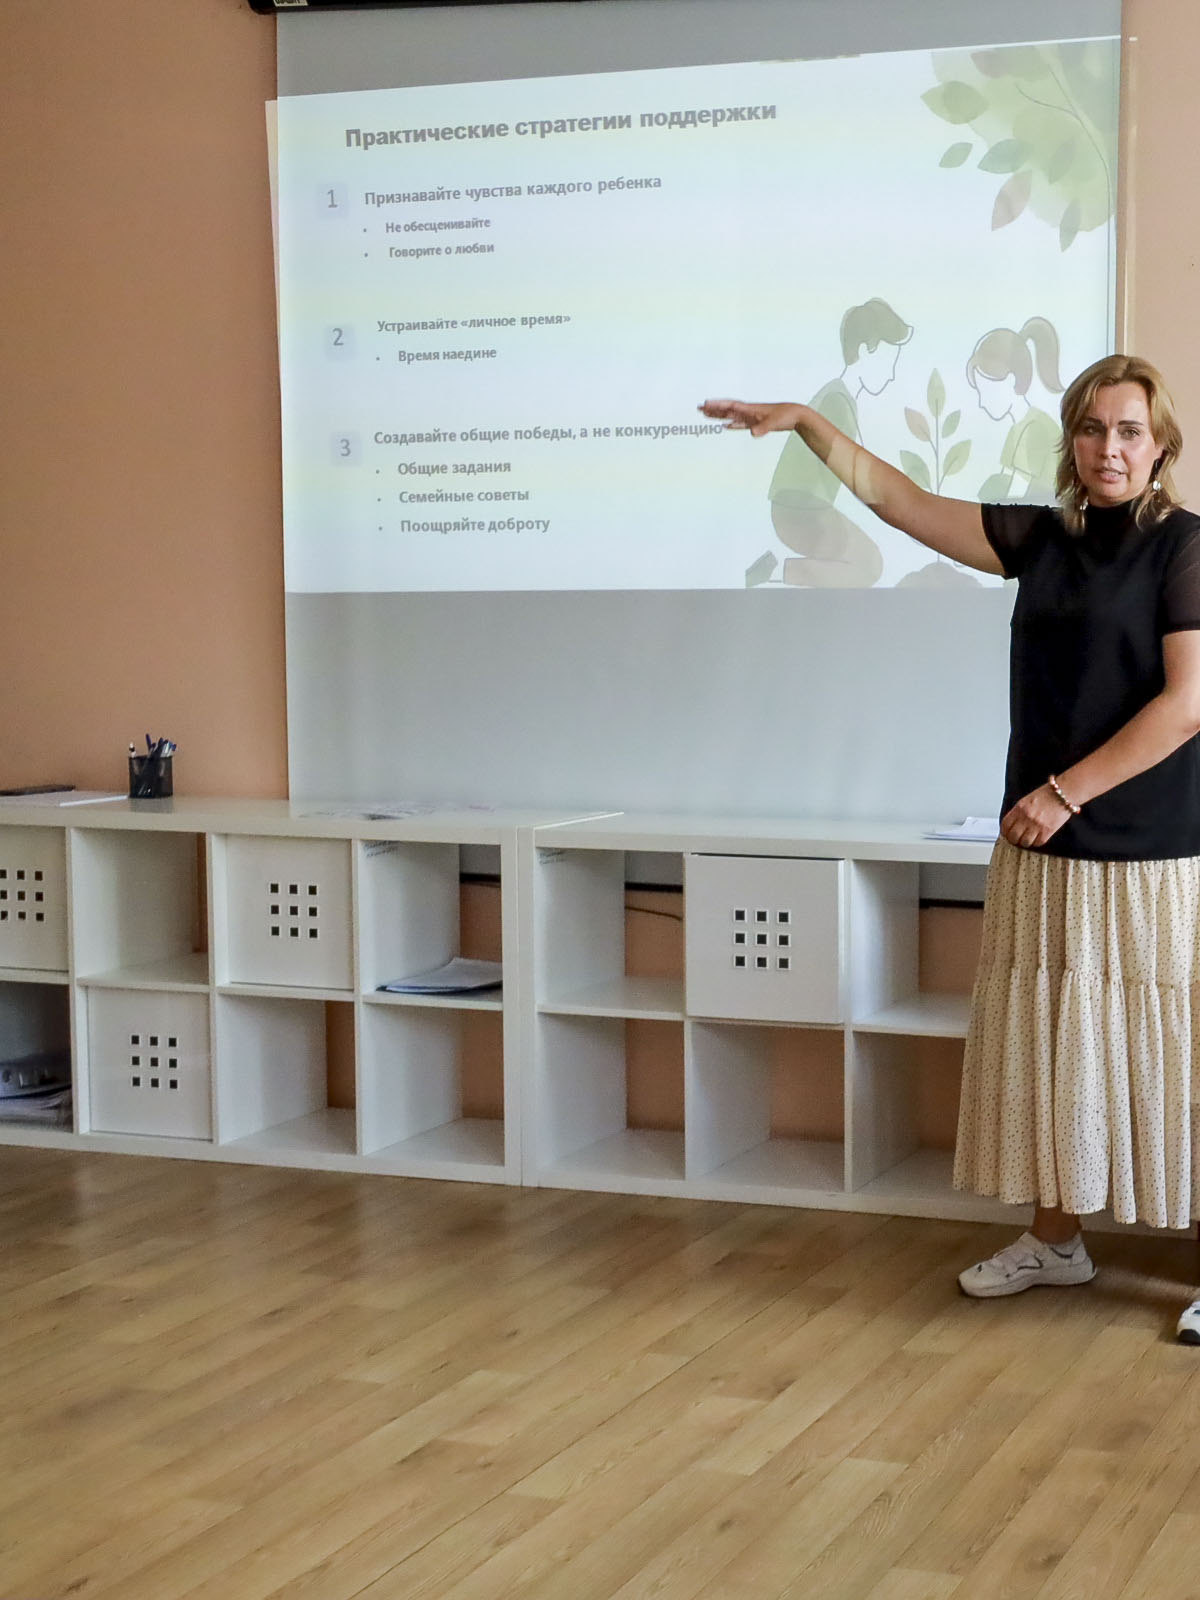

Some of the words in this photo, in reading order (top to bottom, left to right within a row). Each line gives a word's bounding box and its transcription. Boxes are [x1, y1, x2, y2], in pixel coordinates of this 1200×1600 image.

[344, 122, 510, 150] Практические
[514, 114, 633, 139] стратегии
[639, 104, 777, 130] поддержки
[327, 188, 339, 209] 1
[364, 186, 461, 208] Признавайте
[465, 185, 523, 202] чувства
[526, 181, 593, 197] каждого
[597, 175, 662, 196] ребенка
[385, 222, 402, 233] Не
[403, 217, 492, 233] обесценивайте
[389, 246, 442, 259] Говорите
[444, 247, 453, 256] о
[454, 242, 495, 256] любви
[376, 317, 458, 335] Устраивайте
[460, 316, 516, 329] «личное
[520, 314, 571, 329] время»
[332, 327, 345, 347] 2
[398, 350, 440, 365] Время
[442, 347, 497, 362] наедине
[374, 428, 457, 446] Создавайте
[459, 427, 510, 444] общие
[513, 426, 577, 441] победы,
[579, 427, 588, 438] а
[592, 426, 611, 438] не
[615, 423, 724, 440] конкуренцию
[339, 438, 352, 457] 3
[397, 462, 448, 477] Общие
[451, 461, 512, 476] задания
[399, 489, 474, 504] Семейные
[476, 488, 530, 502] советы
[400, 517, 486, 535] Поощряйте
[487, 517, 551, 534] доброту
